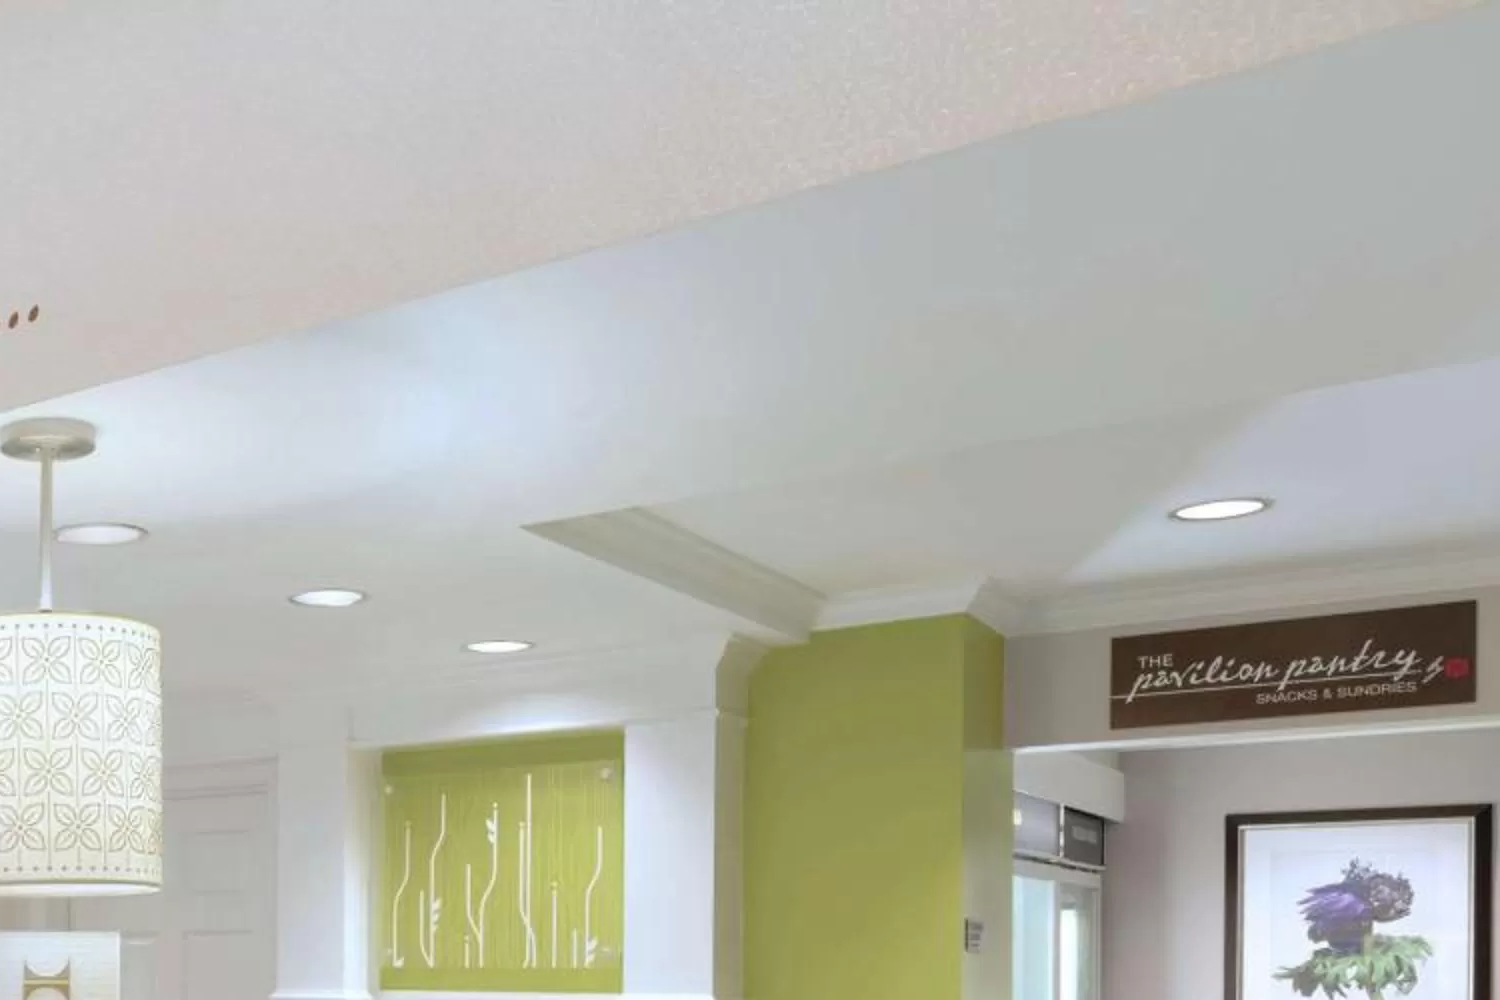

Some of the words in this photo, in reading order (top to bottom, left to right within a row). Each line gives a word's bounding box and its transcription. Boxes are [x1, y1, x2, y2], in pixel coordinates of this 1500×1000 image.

[1125, 655, 1280, 704] pavilion
[1276, 639, 1422, 691] pantry
[1137, 653, 1174, 669] THE
[1255, 690, 1318, 705] SNACKS
[1337, 681, 1418, 699] SUNDRIES
